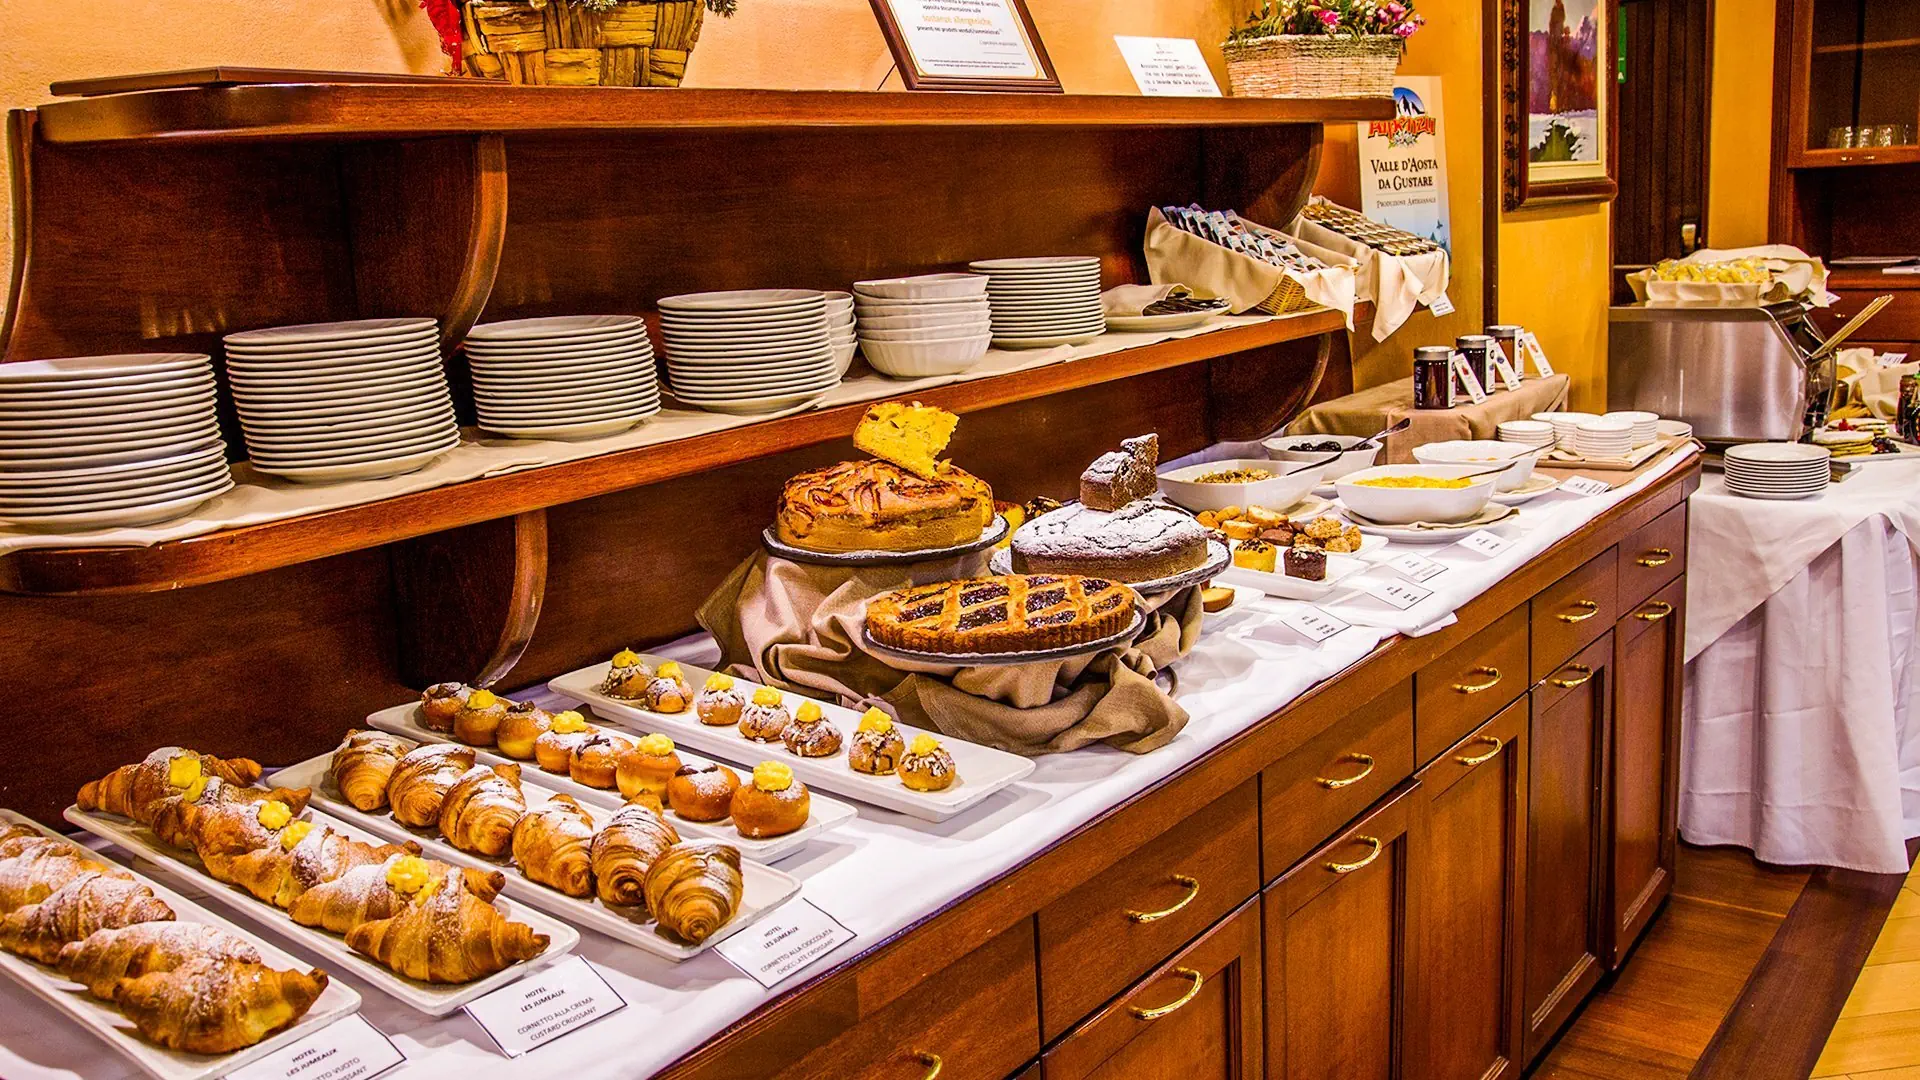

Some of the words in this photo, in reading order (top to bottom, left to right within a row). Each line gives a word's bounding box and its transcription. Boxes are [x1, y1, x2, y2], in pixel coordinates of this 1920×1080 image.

[763, 940, 776, 950] LES
[775, 926, 800, 945] JUMEAUX
[764, 924, 783, 938] HOTEL
[760, 952, 790, 973] CORNETTO
[789, 946, 802, 957] ALLA
[807, 938, 836, 957] CROISSANT
[520, 1003, 533, 1013] LES
[533, 989, 566, 1008] JUMEAUX
[524, 986, 547, 999] HOTEL
[517, 1014, 554, 1035] CORNETTO
[554, 1006, 571, 1020] ALLA
[570, 996, 595, 1011] CREMA
[530, 1022, 562, 1041] CUSTARD
[561, 1005, 597, 1027] CROISSANT
[286, 1066, 300, 1077] LES
[300, 1048, 337, 1070] JUMEAUX
[292, 1048, 317, 1063] HOTEL
[332, 1057, 361, 1074] VUOTO
